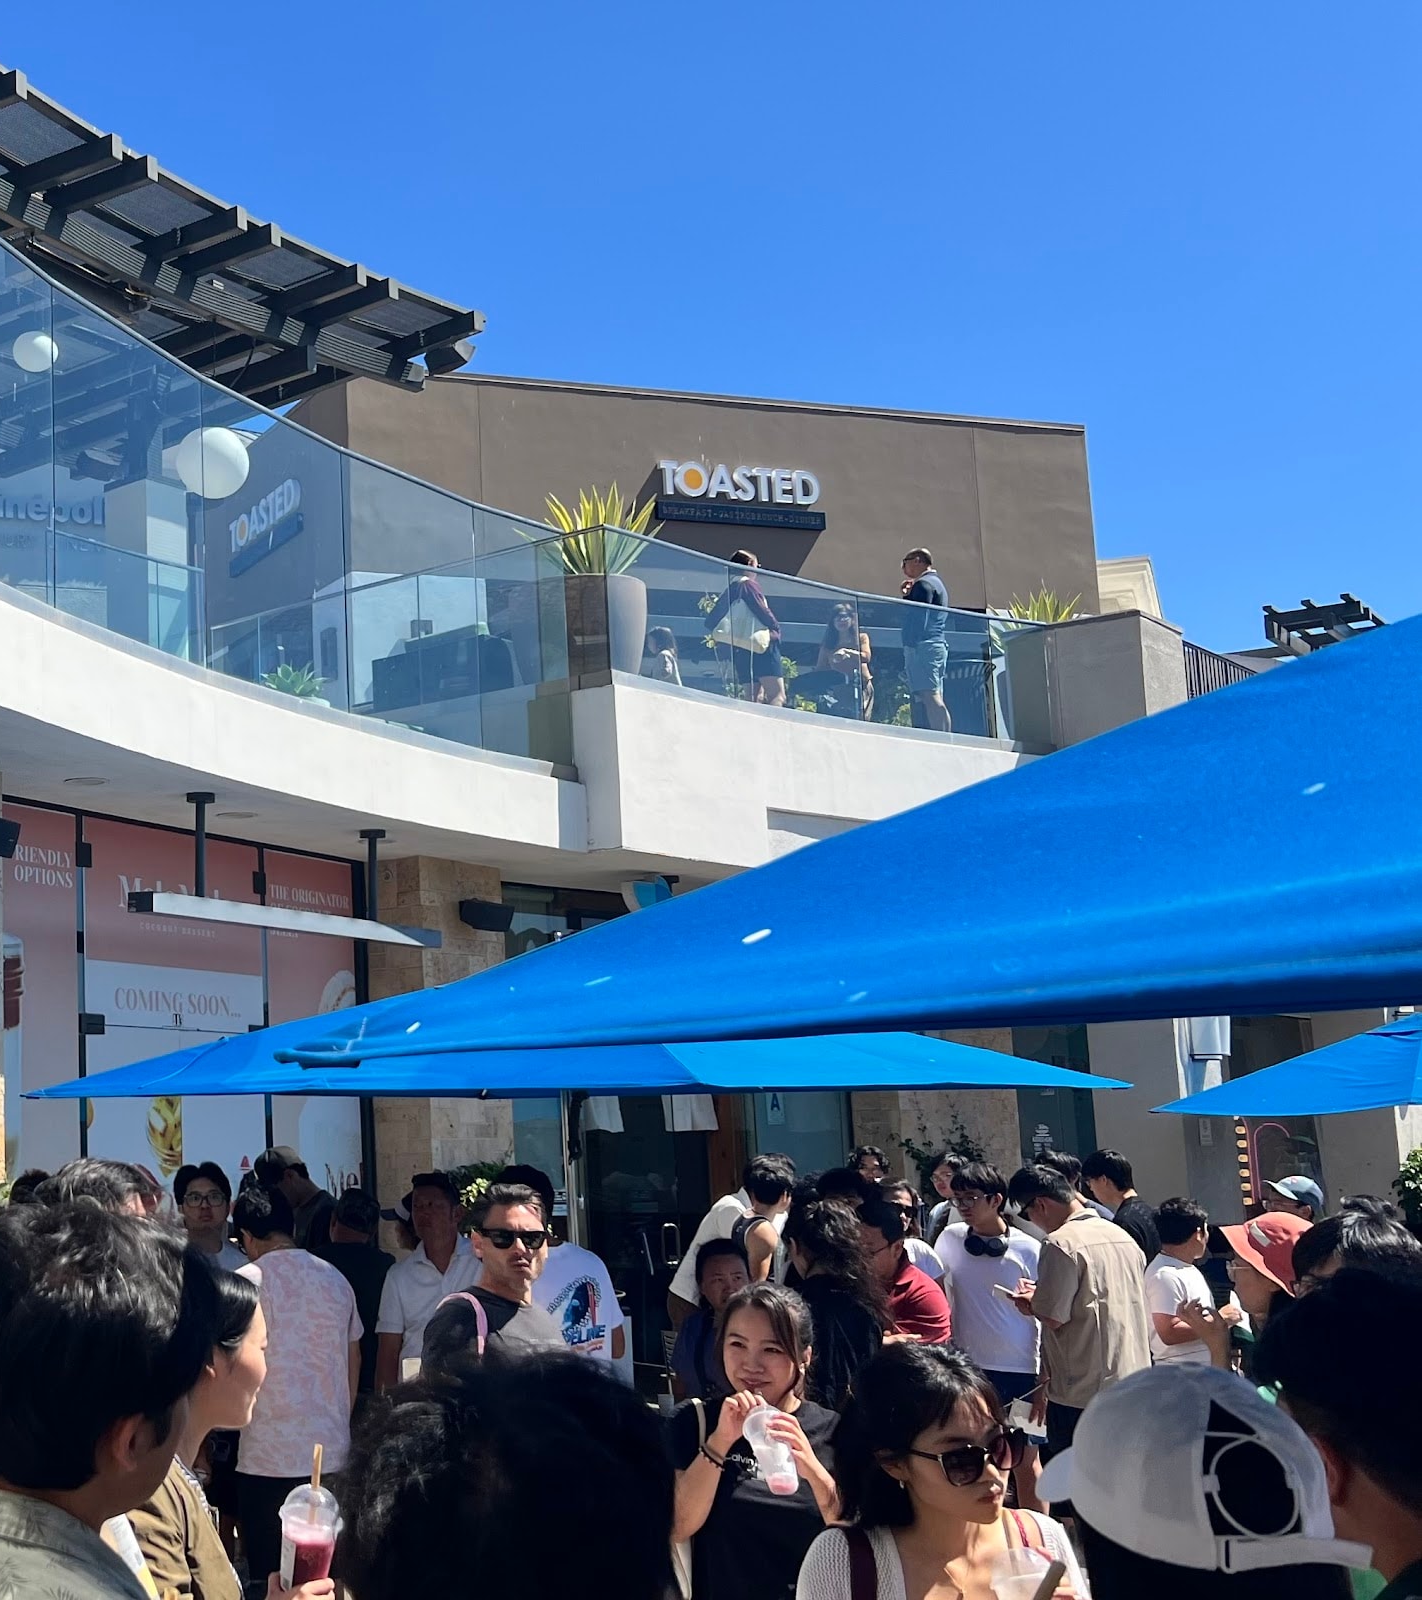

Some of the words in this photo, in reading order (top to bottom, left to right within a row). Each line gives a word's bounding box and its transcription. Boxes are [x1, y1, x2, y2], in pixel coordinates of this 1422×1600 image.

[657, 459, 821, 506] TOASTED
[229, 478, 301, 553] TOASTED
[15, 844, 72, 868] RIENDLY
[14, 864, 74, 889] OPTIONS
[269, 884, 289, 901] THE
[291, 888, 350, 909] ORIGINATOR
[114, 987, 184, 1014] COMING
[770, 1092, 781, 1111] A
